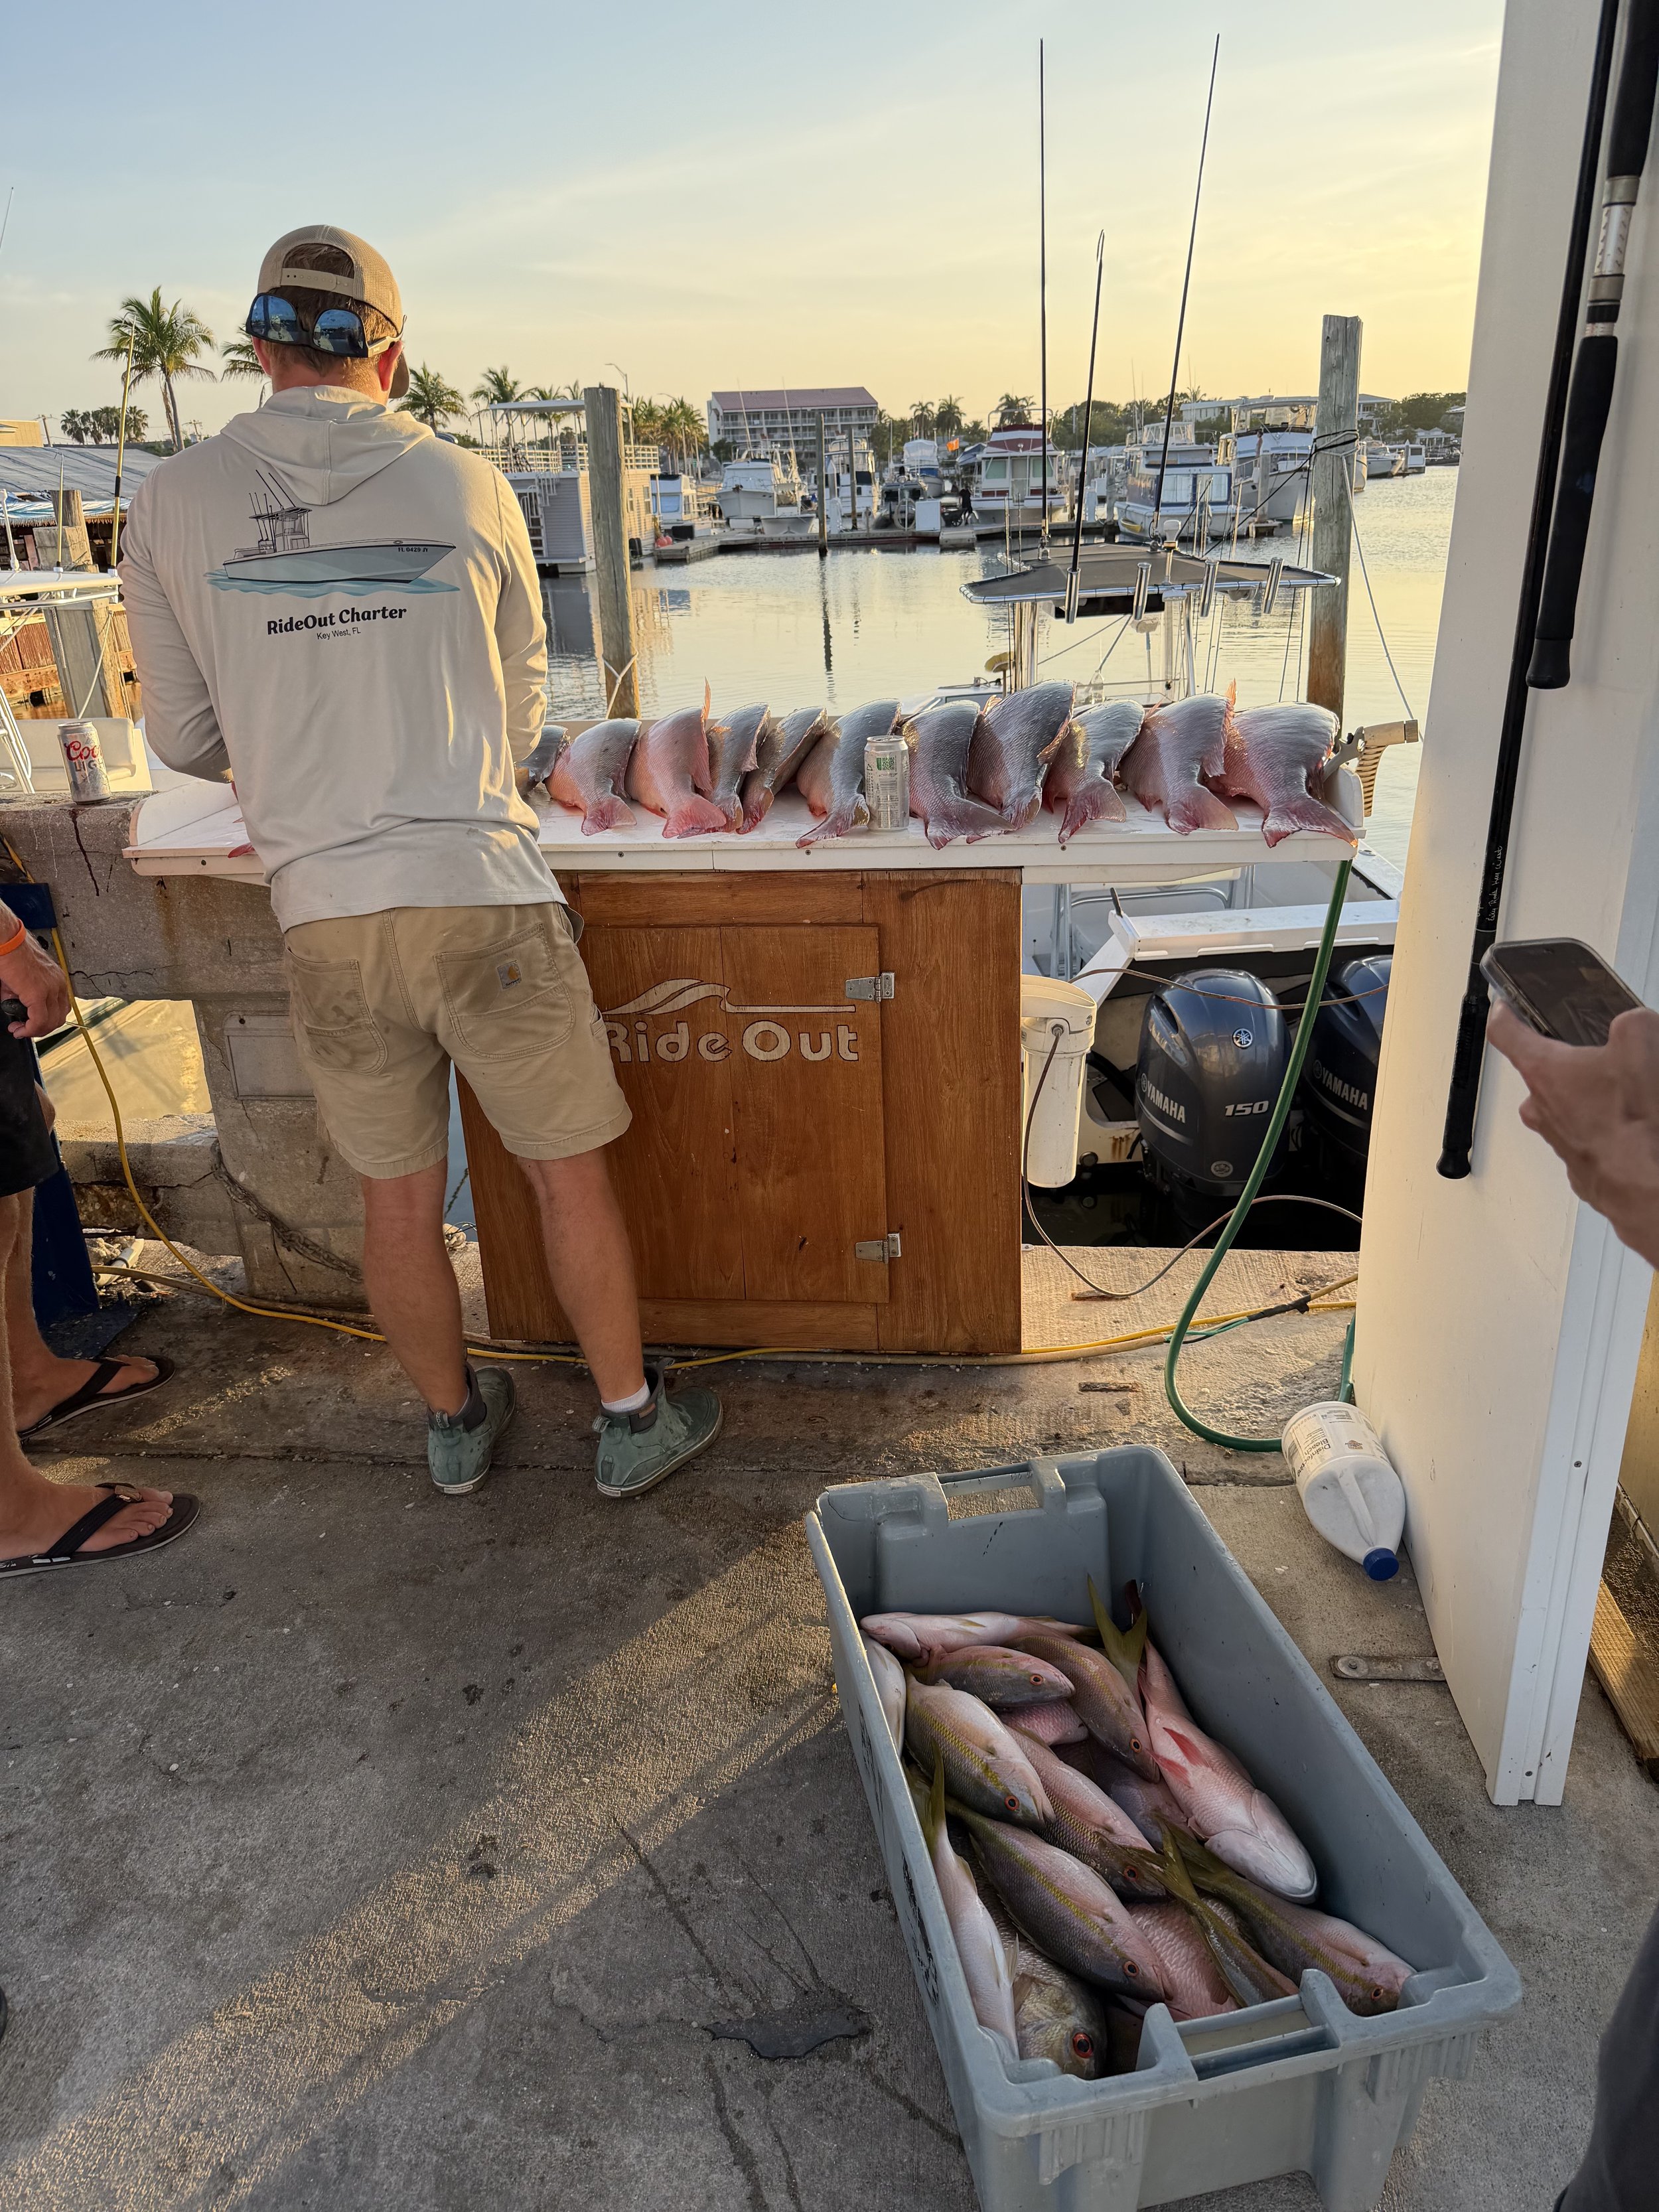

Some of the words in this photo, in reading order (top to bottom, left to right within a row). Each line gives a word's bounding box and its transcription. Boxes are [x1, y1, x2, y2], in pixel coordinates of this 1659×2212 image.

[267, 613, 336, 635] RideOut
[339, 606, 407, 624] Charter
[332, 628, 351, 637] West,
[64, 741, 103, 761] Coo
[74, 760, 100, 771] LIG
[604, 1020, 733, 1063] Ride
[742, 1019, 859, 1062] Out
[1323, 1067, 1368, 1111] YAMAHA
[1147, 1080, 1186, 1124] YAMAHA
[1225, 1100, 1269, 1117] 150
[1305, 1438, 1329, 1455] Bleach
[1297, 1443, 1331, 1477] Disinfecting
